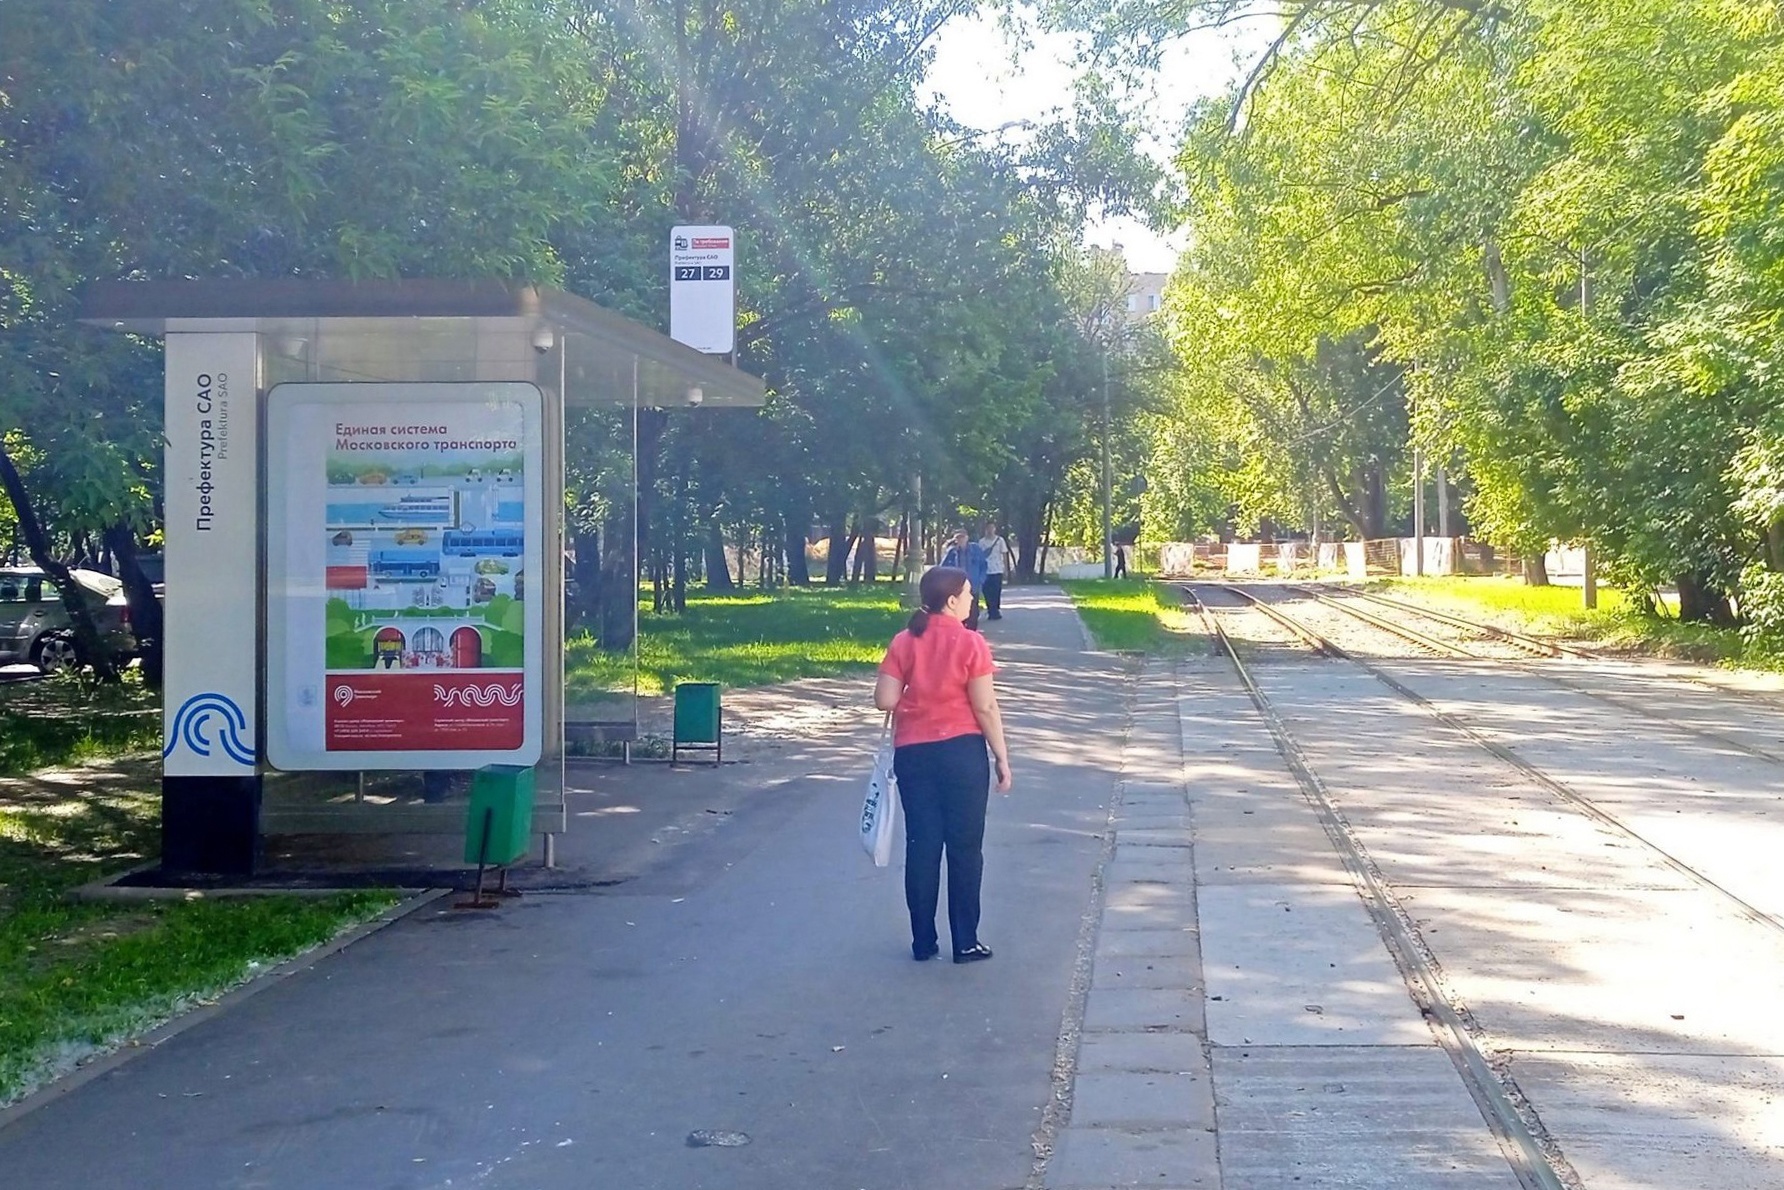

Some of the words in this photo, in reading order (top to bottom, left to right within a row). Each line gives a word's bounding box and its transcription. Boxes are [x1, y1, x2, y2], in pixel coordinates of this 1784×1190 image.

[681, 268, 695, 279] 27
[708, 268, 724, 279] 29
[197, 373, 212, 414] САО
[217, 372, 228, 398] SAO
[217, 400, 228, 460] Prefektura
[335, 423, 386, 437] Единая
[390, 425, 448, 435] система
[335, 438, 430, 451] Московского
[434, 439, 517, 453] транспорта
[196, 420, 215, 531] Префектура
